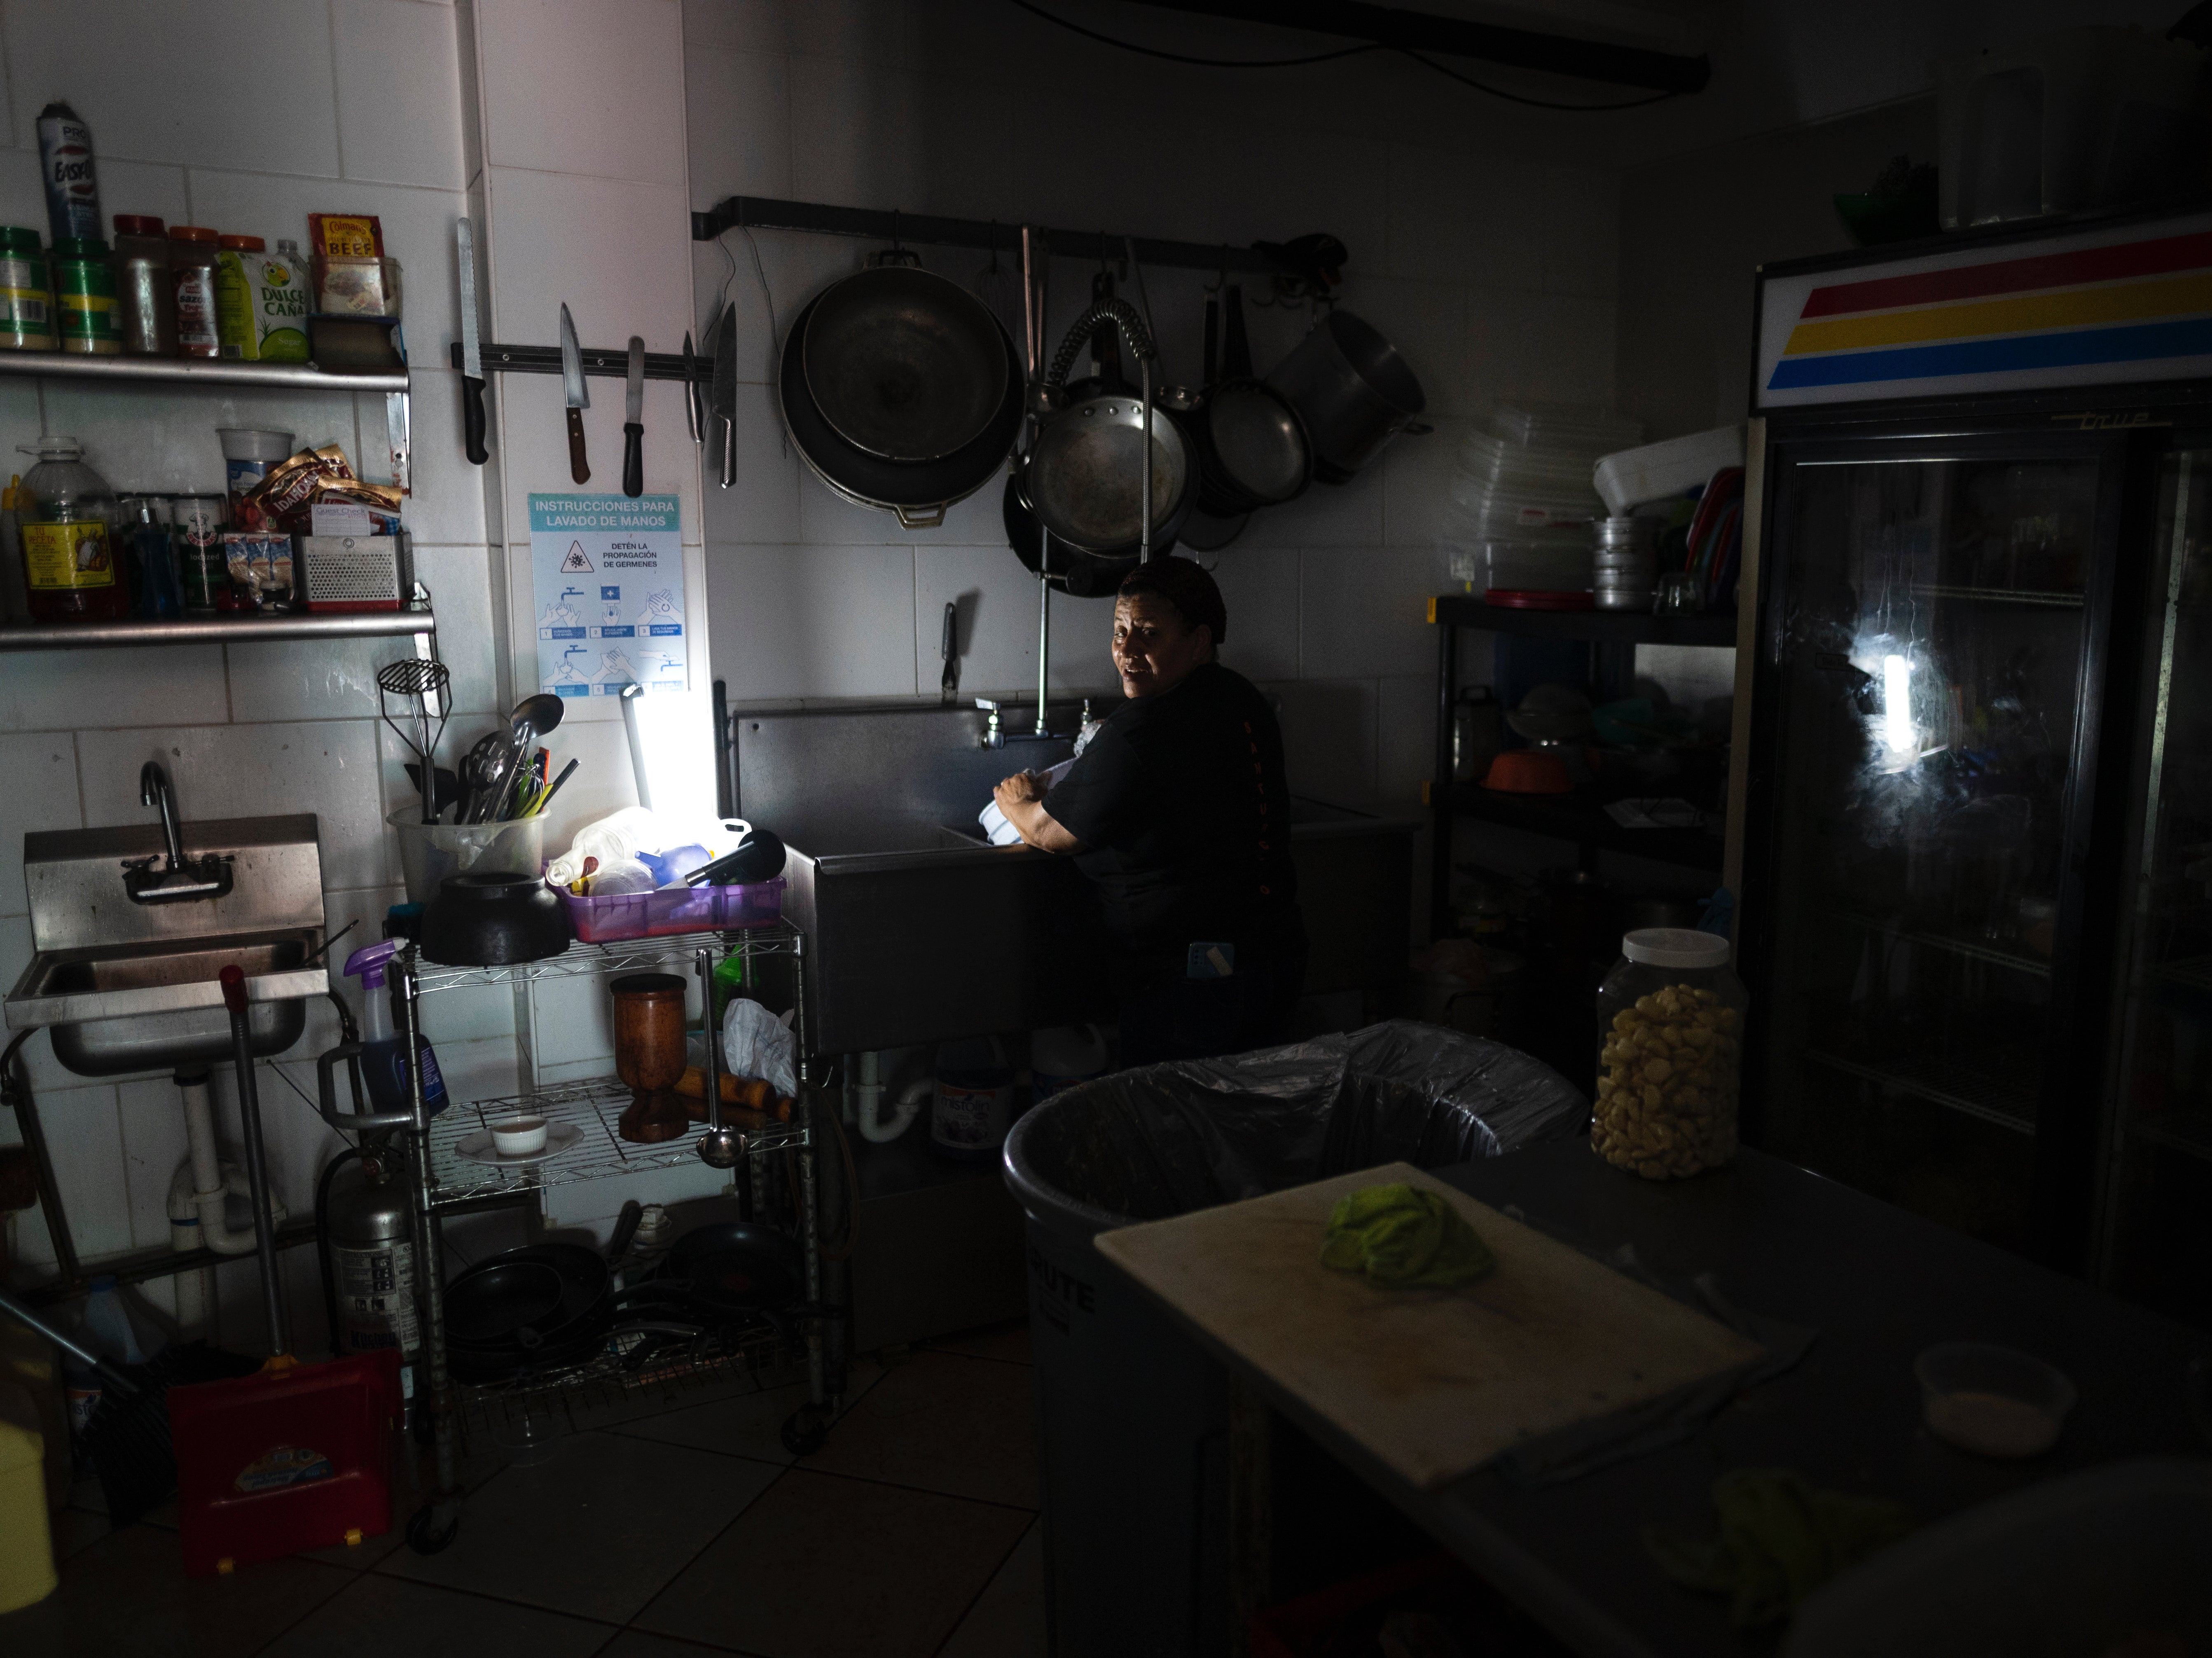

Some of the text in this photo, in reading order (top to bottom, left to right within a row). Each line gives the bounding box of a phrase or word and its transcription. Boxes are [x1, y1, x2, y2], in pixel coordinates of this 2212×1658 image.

[329, 243, 372, 255] BEEF
[261, 287, 305, 304] DULCE
[264, 302, 304, 317] CAÑA
[274, 471, 320, 512] IDAHOAN
[535, 501, 674, 512] INSTRUCCIONES PARA
[547, 515, 666, 527] LAVADO DE MANOS
[612, 541, 636, 550] DETÉN
[603, 550, 657, 559] PROPAGACIÓN
[941, 1096, 990, 1113] mistolin
